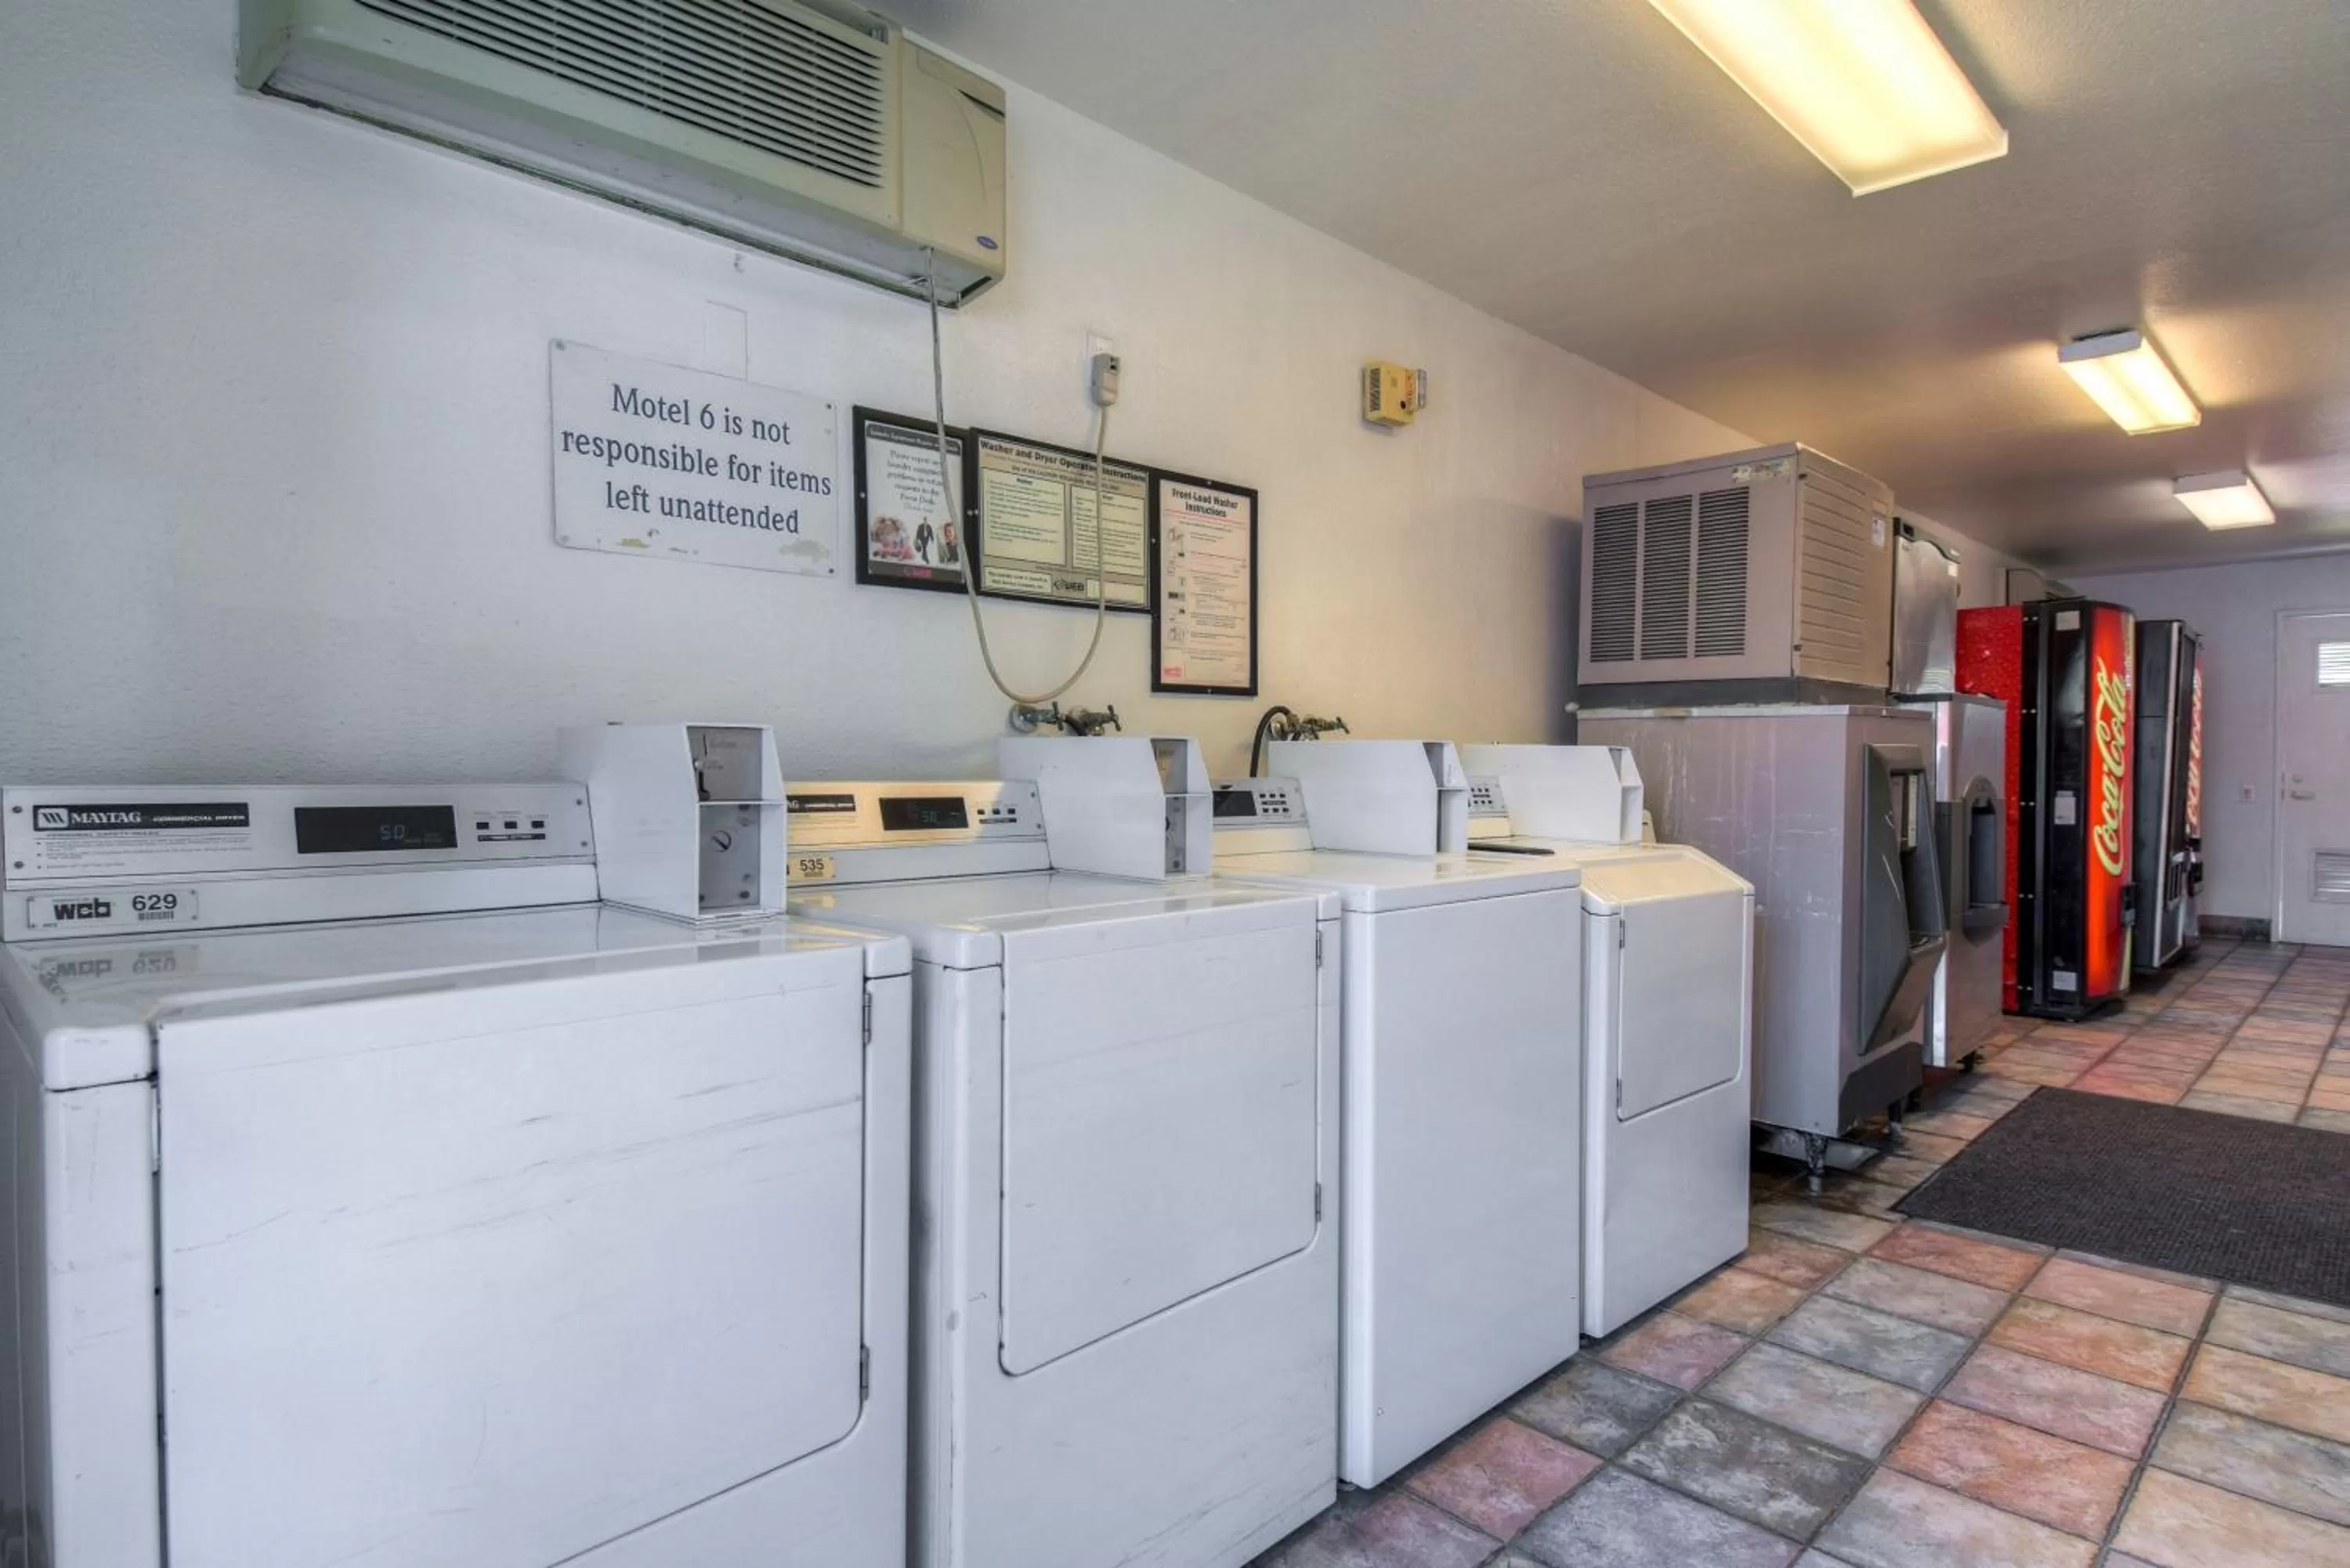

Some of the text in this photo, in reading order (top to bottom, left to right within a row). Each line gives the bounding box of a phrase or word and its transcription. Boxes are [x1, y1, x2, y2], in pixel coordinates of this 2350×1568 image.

[611, 383, 791, 445] Motel 6 is not
[561, 430, 831, 495] responsible for items
[605, 480, 799, 534] left unattended
[2093, 656, 2125, 876] Coca-Cola
[70, 811, 142, 824] MAYTAG
[799, 858, 825, 872] 535
[53, 894, 178, 920] web 629
